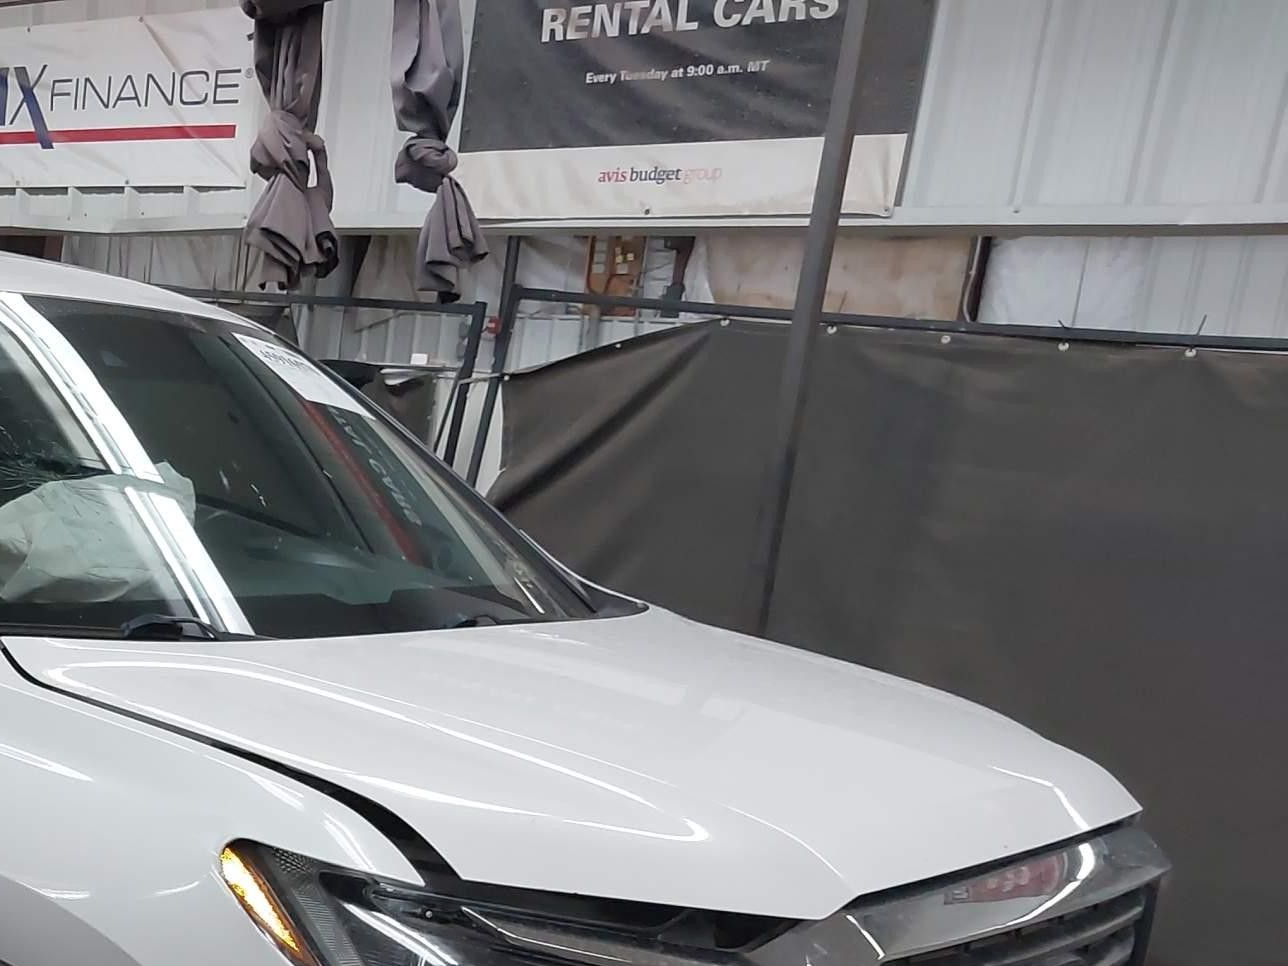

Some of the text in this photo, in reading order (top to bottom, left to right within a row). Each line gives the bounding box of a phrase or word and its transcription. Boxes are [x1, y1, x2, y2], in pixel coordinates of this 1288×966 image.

[541, 0, 840, 42] RENTAL CARS
[585, 72, 616, 84] Every
[619, 69, 668, 81] Tuesday
[671, 66, 684, 78] at
[686, 64, 714, 77] 9:00
[716, 64, 743, 75] a.m.
[598, 168, 627, 183] avis
[629, 166, 682, 184] budget
